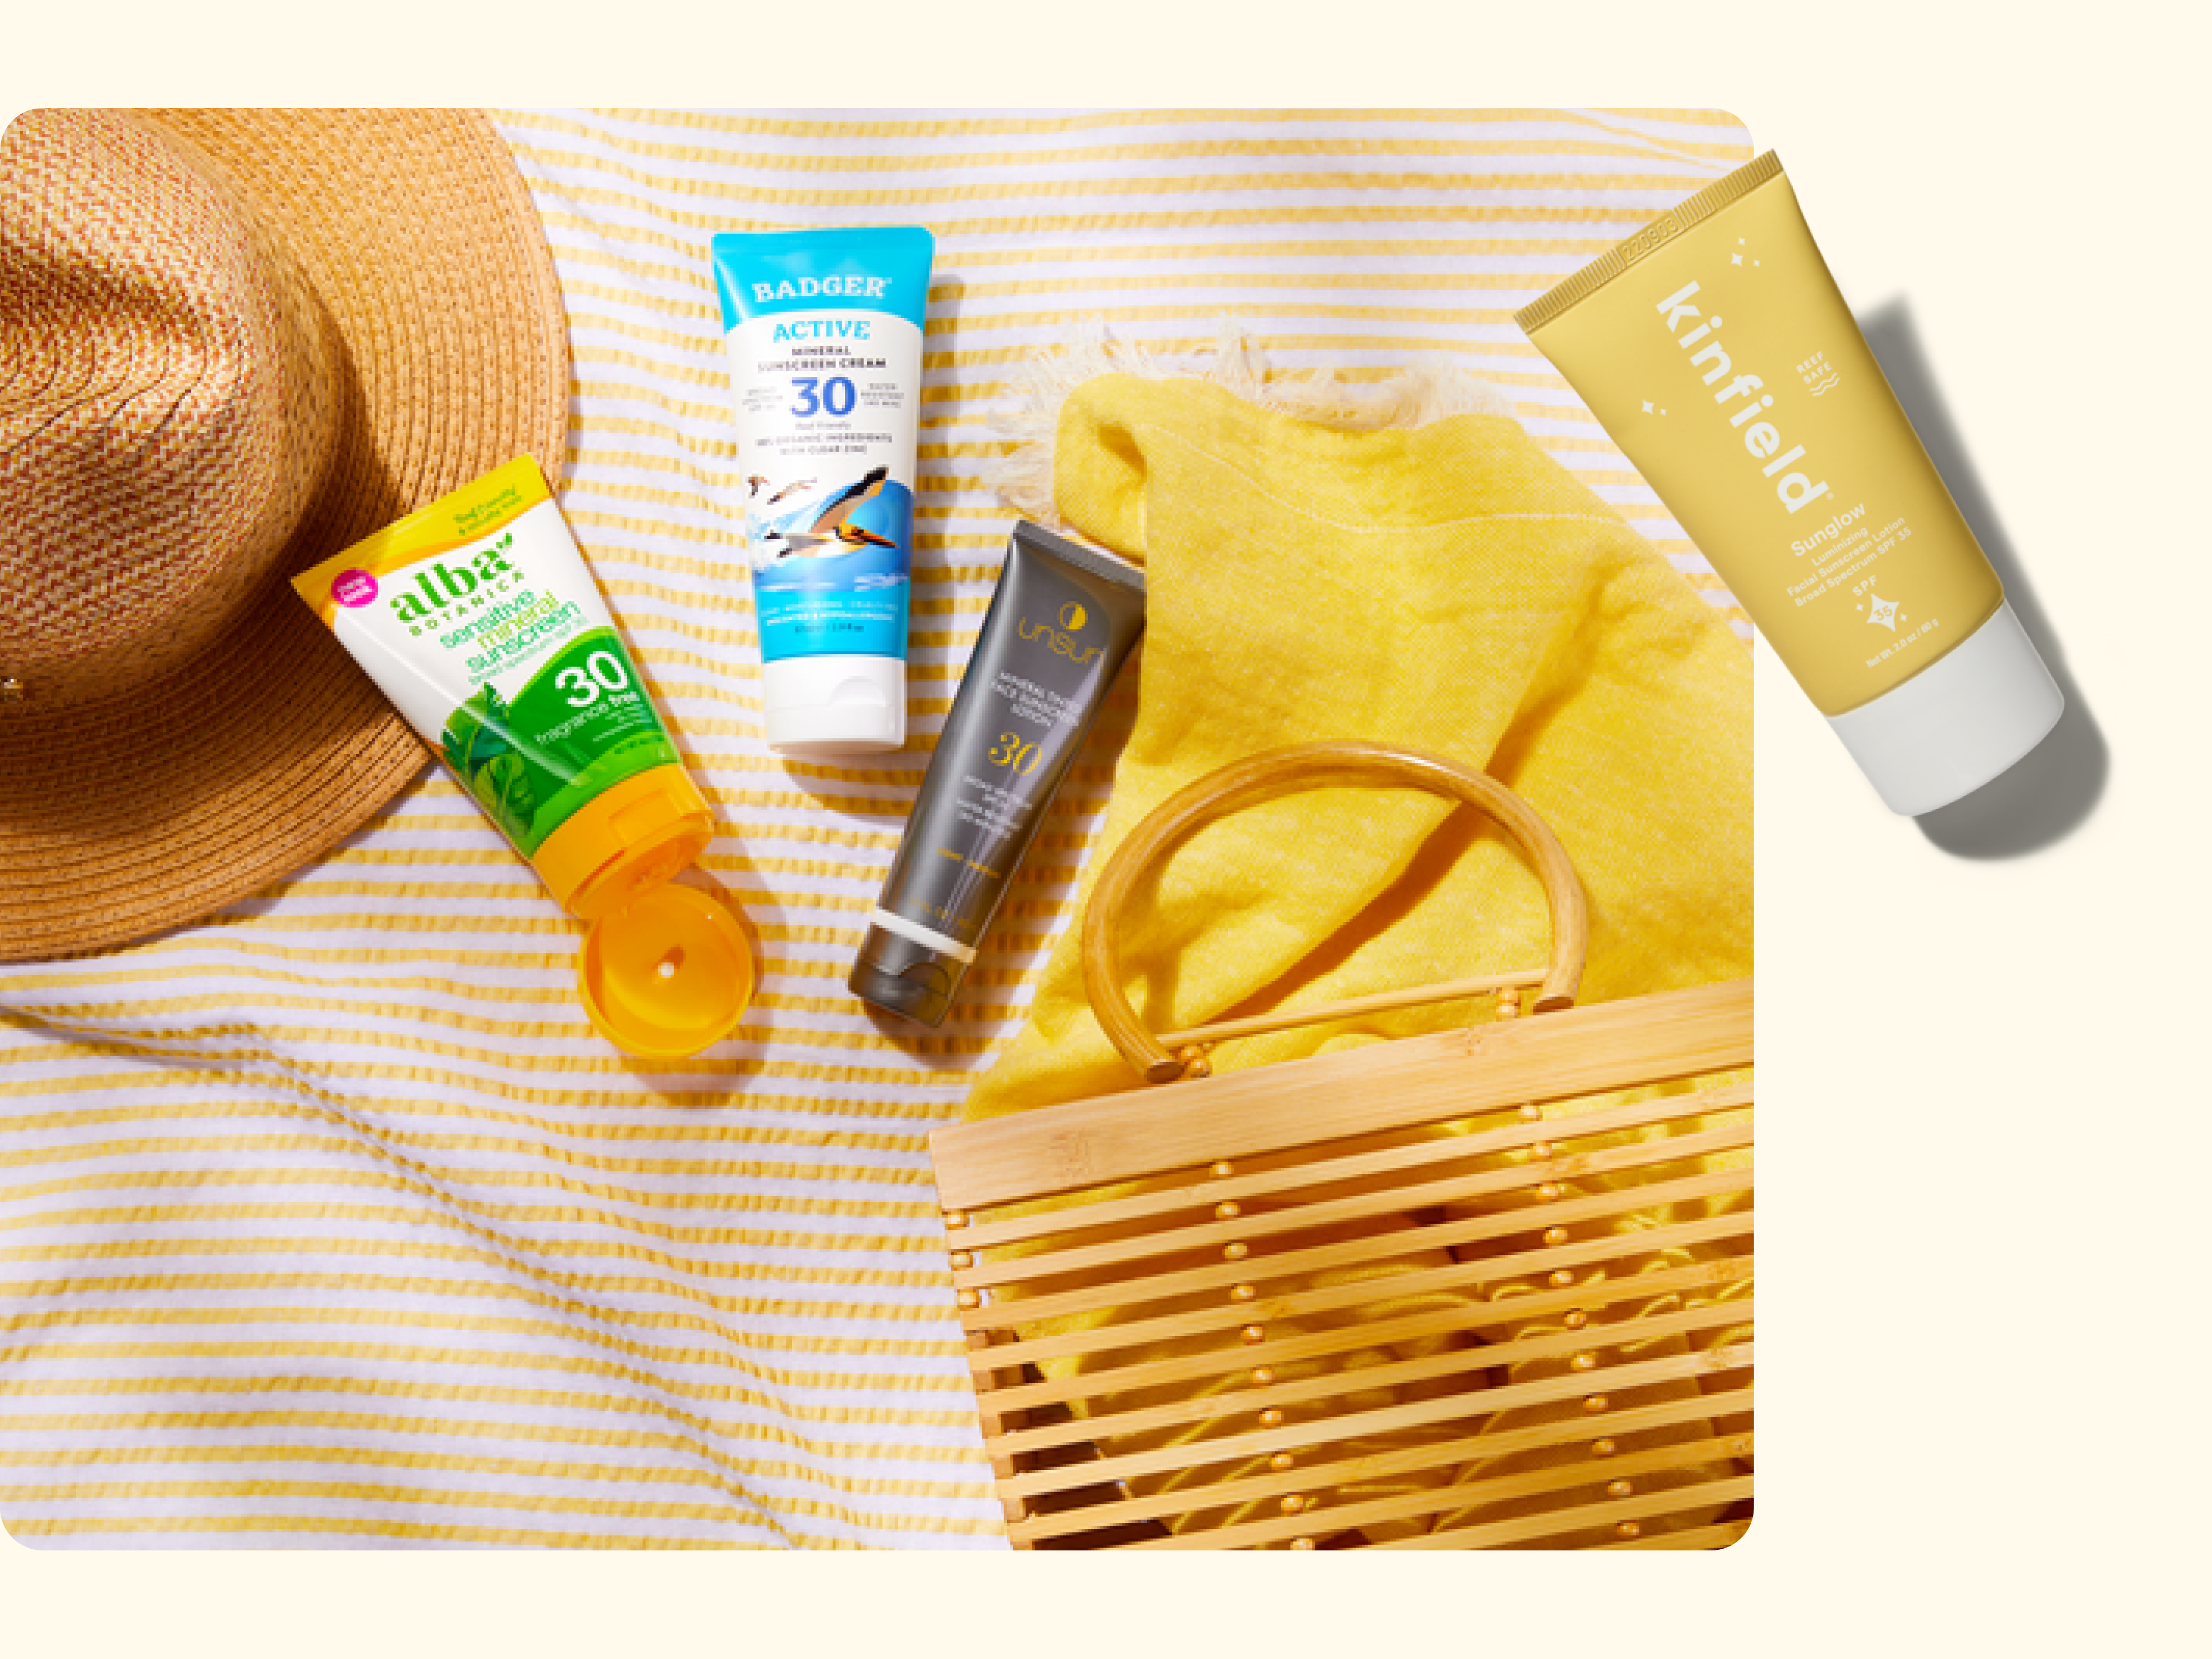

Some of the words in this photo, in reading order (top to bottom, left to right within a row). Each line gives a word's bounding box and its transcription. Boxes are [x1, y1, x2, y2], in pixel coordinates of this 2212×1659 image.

[1624, 217, 1679, 260] 220903
[752, 274, 885, 303] BADGER
[774, 320, 870, 343] ACTIVE
[792, 345, 852, 356] MINERAL
[758, 358, 836, 371] SUNSCREEN
[841, 358, 887, 368] CREAM
[1796, 350, 1824, 374] REEF
[1803, 361, 1832, 384] SAFE
[789, 376, 858, 418] 30
[1656, 280, 1830, 515] kinfield
[1791, 502, 1865, 556] Sunglow
[1811, 527, 1869, 566] Luminizing
[1787, 573, 1819, 596] Facial
[1818, 539, 1873, 577] Sunscreen
[1872, 518, 1905, 542] Lotion
[1794, 583, 1827, 607] Broad
[1826, 552, 1877, 588] Spectrum
[1877, 536, 1896, 555] SPF
[1896, 527, 1912, 541] 35
[390, 548, 513, 622] alba
[409, 567, 524, 636] BOTANICA
[1852, 574, 1877, 596] SPF
[440, 588, 537, 649] sensitive
[478, 588, 559, 649] mineral
[1874, 605, 1892, 621] 35
[465, 601, 582, 673] sunscreen
[1017, 617, 1107, 671] unsun
[1865, 655, 1882, 668] Net
[1880, 648, 1895, 660] Wt.
[1893, 639, 1907, 651] 2.0
[1907, 633, 1917, 643] oz
[555, 650, 628, 707] 30
[533, 703, 609, 744] fragrance
[609, 691, 640, 707] free
[988, 731, 1045, 776] 30
